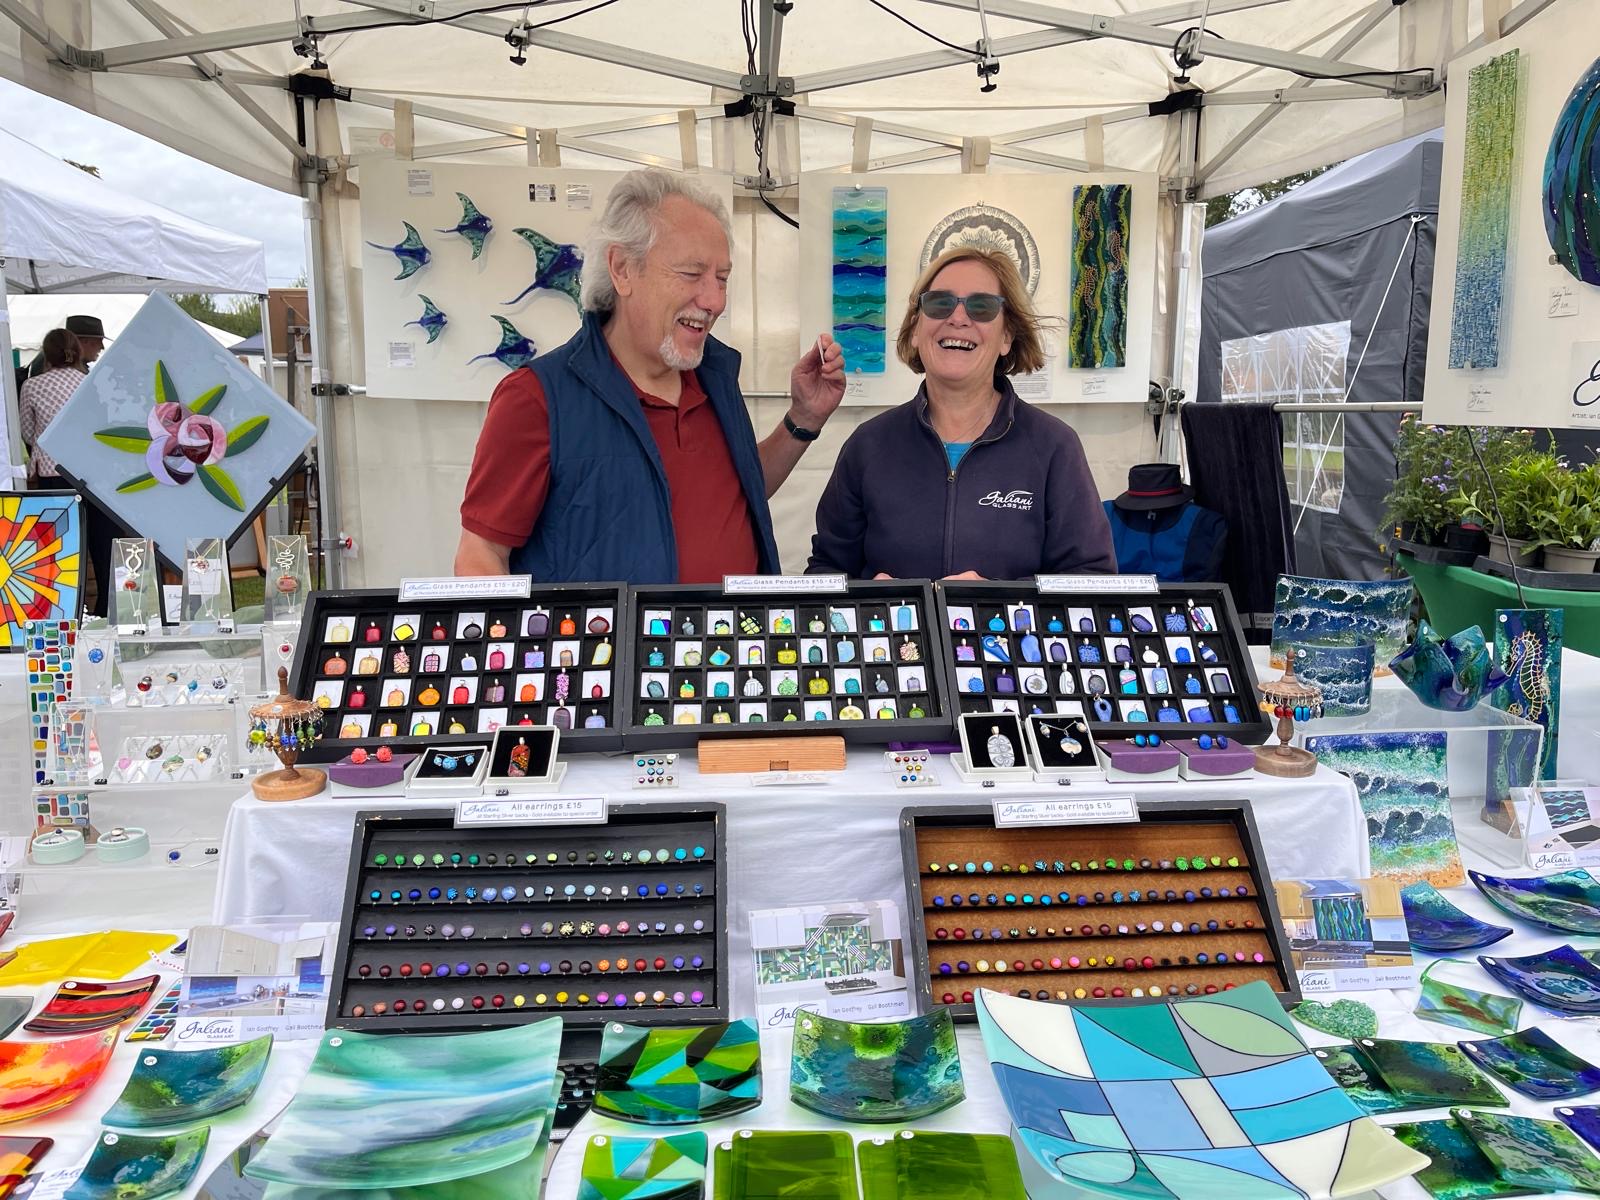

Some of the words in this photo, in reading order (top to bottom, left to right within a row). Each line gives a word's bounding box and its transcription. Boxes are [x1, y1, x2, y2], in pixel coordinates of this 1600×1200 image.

[978, 490, 1034, 506] Galiani
[525, 803, 563, 811] earrings
[1058, 803, 1094, 811] earrings
[1299, 972, 1330, 986] liani
[178, 1020, 234, 1039] Galiani
